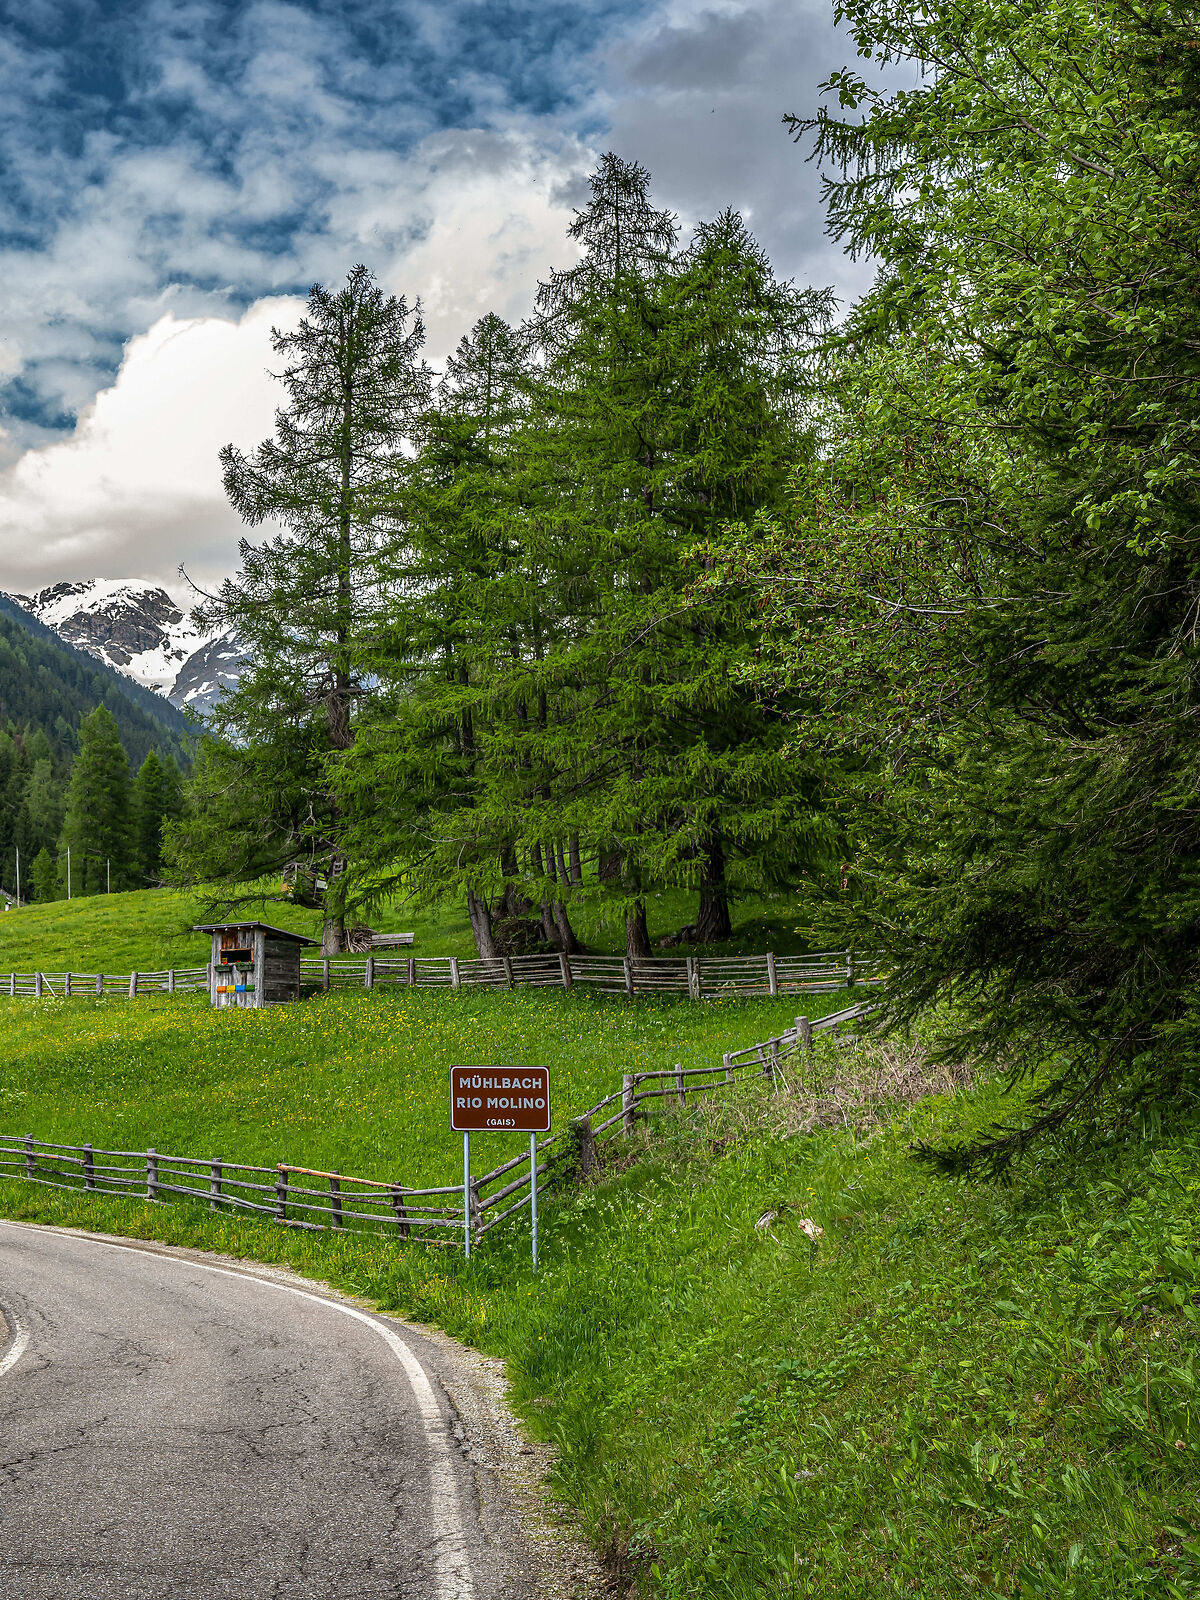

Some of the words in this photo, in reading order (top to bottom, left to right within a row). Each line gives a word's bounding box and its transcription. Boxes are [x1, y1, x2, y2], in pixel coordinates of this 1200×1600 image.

[459, 1075, 542, 1089] MÜHLBACH
[456, 1097, 482, 1109] RIO
[487, 1097, 545, 1109] MOLINO
[486, 1118, 516, 1127] (GAIS)
